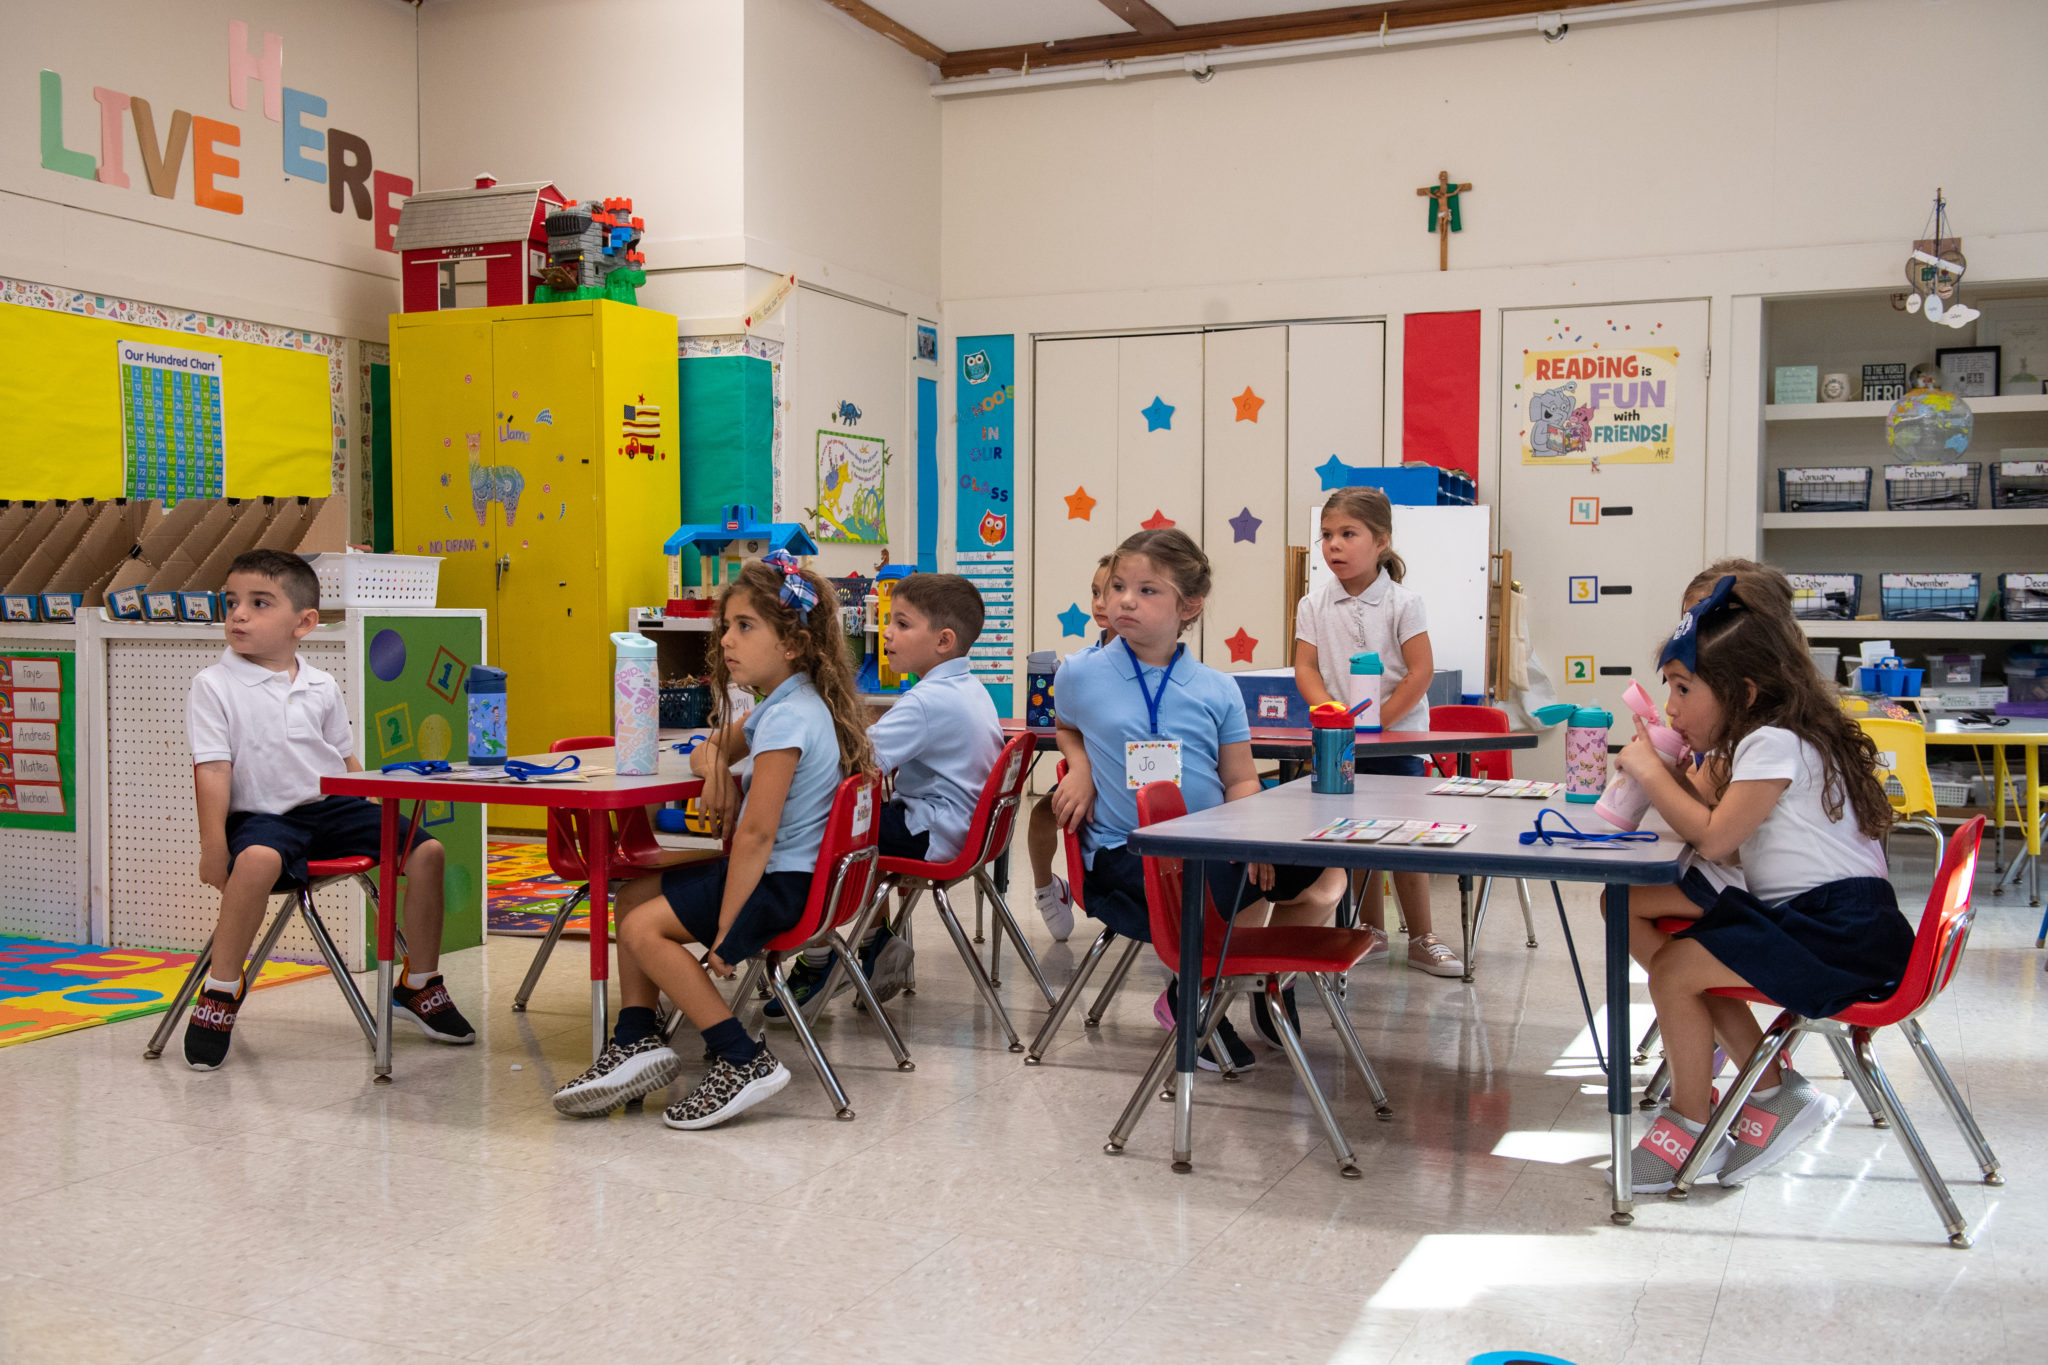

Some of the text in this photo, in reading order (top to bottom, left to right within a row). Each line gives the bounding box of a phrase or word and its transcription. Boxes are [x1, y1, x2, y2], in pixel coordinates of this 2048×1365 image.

[40, 19, 414, 254] LIVE HERE
[125, 349, 215, 371] Our Hundred Chart
[1641, 366, 1652, 376] is
[1590, 380, 1666, 409] FUN
[1864, 385, 1904, 401] HERO
[1614, 410, 1640, 421] with
[982, 427, 999, 440] IN
[970, 447, 1002, 462] OUR
[1799, 471, 1836, 482] January
[1905, 467, 1945, 479] February
[960, 475, 1009, 502] CLASS
[1577, 502, 1590, 519] 4
[429, 539, 476, 554] NO DRAMA
[1793, 577, 1827, 588] October
[1905, 577, 1949, 588] November
[1577, 582, 1589, 599] 3
[23, 665, 43, 682] Faye
[437, 662, 453, 690] 1
[1574, 661, 1586, 678] 2
[30, 698, 45, 712] Mia
[18, 727, 50, 742] Andreas
[387, 717, 403, 746] 2
[20, 759, 48, 773] Matteo
[1139, 756, 1156, 772] Jo
[20, 792, 48, 804] Michael
